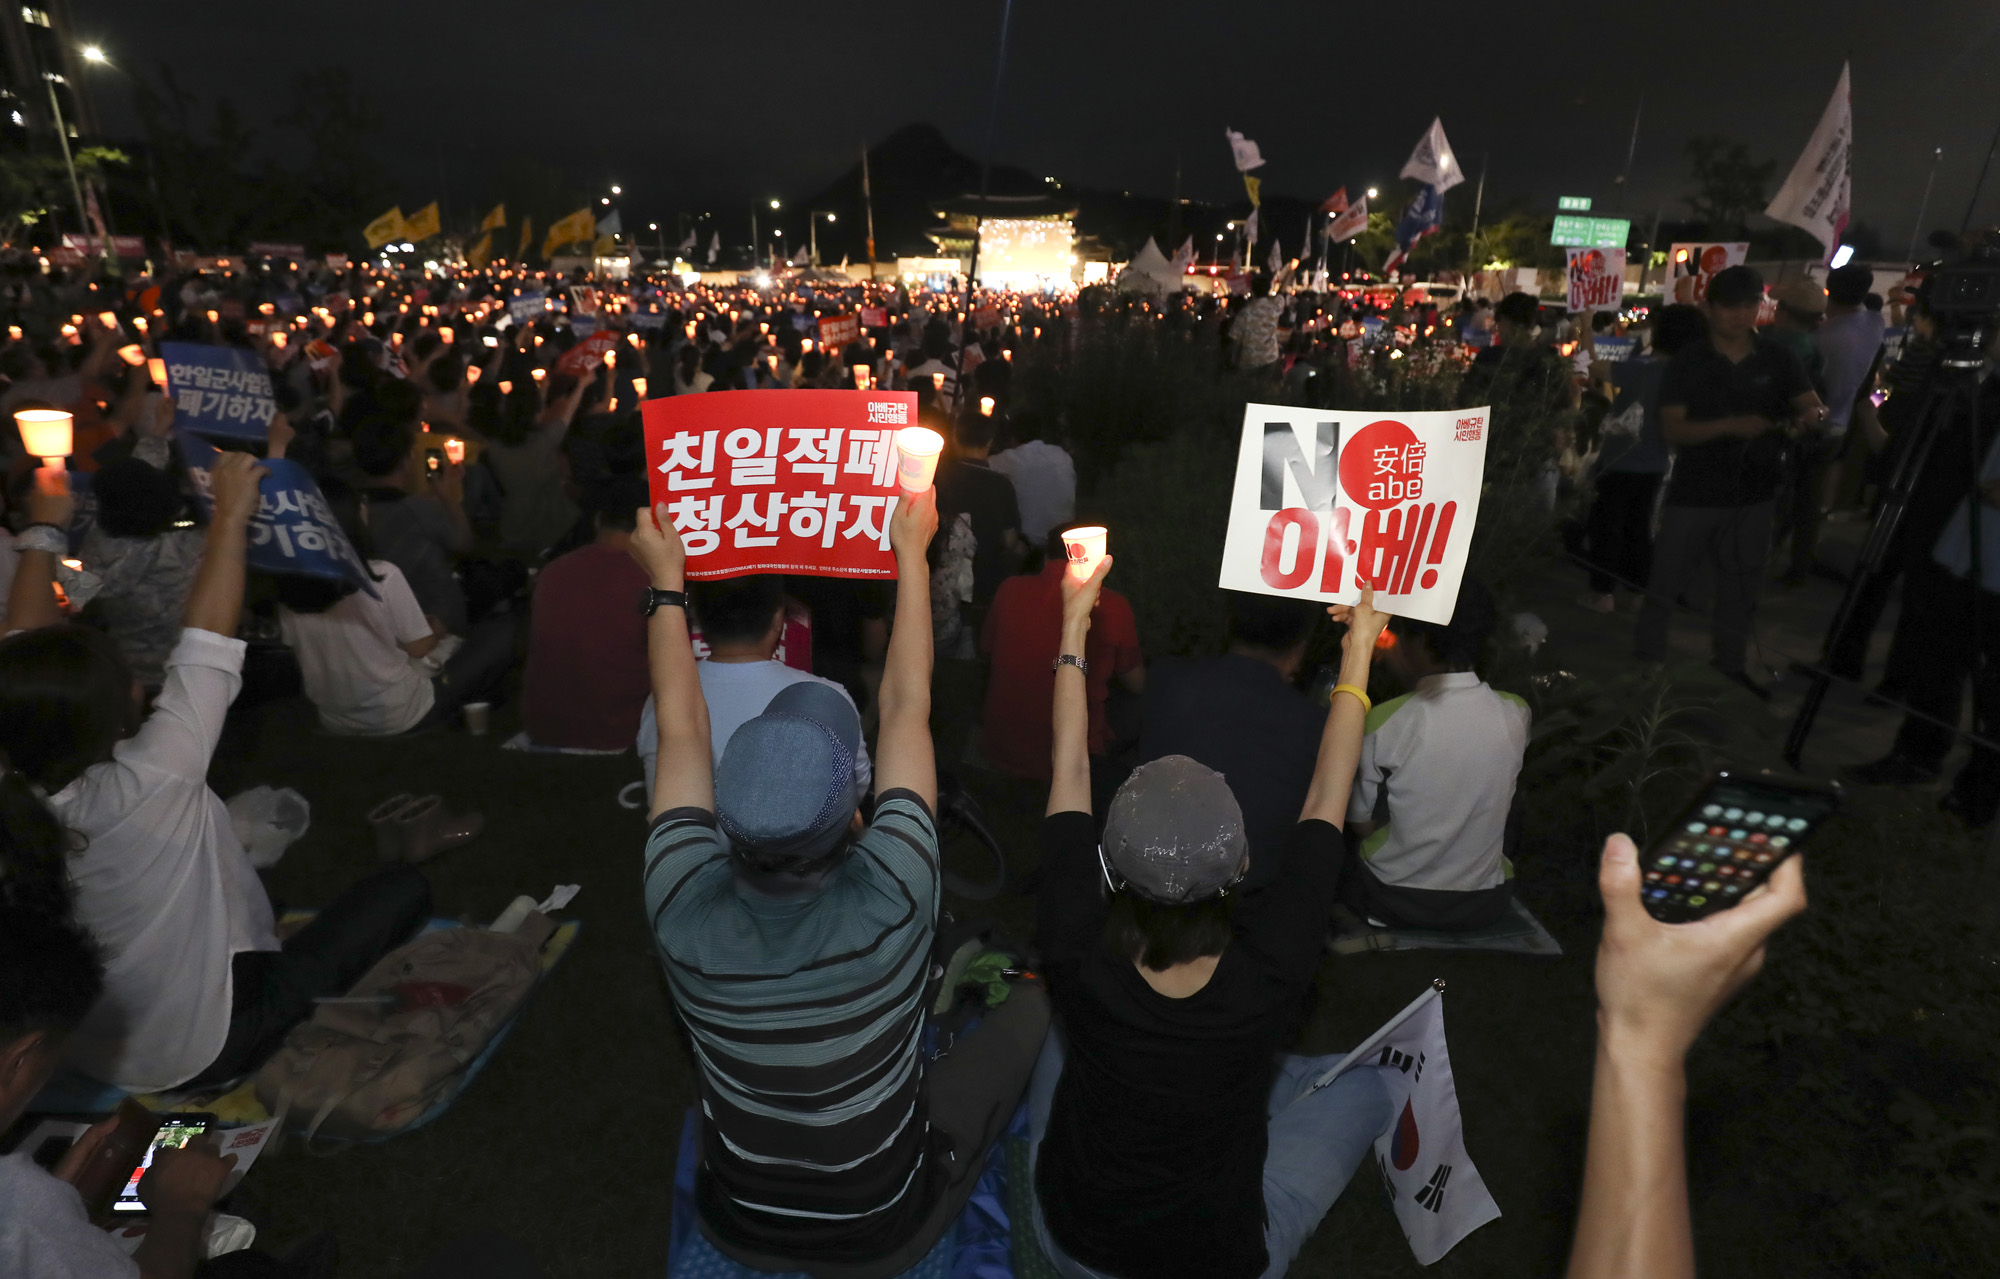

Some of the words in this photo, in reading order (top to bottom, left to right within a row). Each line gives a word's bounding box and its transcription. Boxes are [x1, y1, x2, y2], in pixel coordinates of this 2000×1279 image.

[867, 402, 908, 414] 아베규탄
[867, 413, 908, 424] 시민행동
[1456, 417, 1484, 430] 아베규탄
[1454, 429, 1482, 441] 시민행동
[657, 427, 900, 492] 친일적폐
[1373, 441, 1427, 475] 安倍
[1368, 475, 1423, 501] abe
